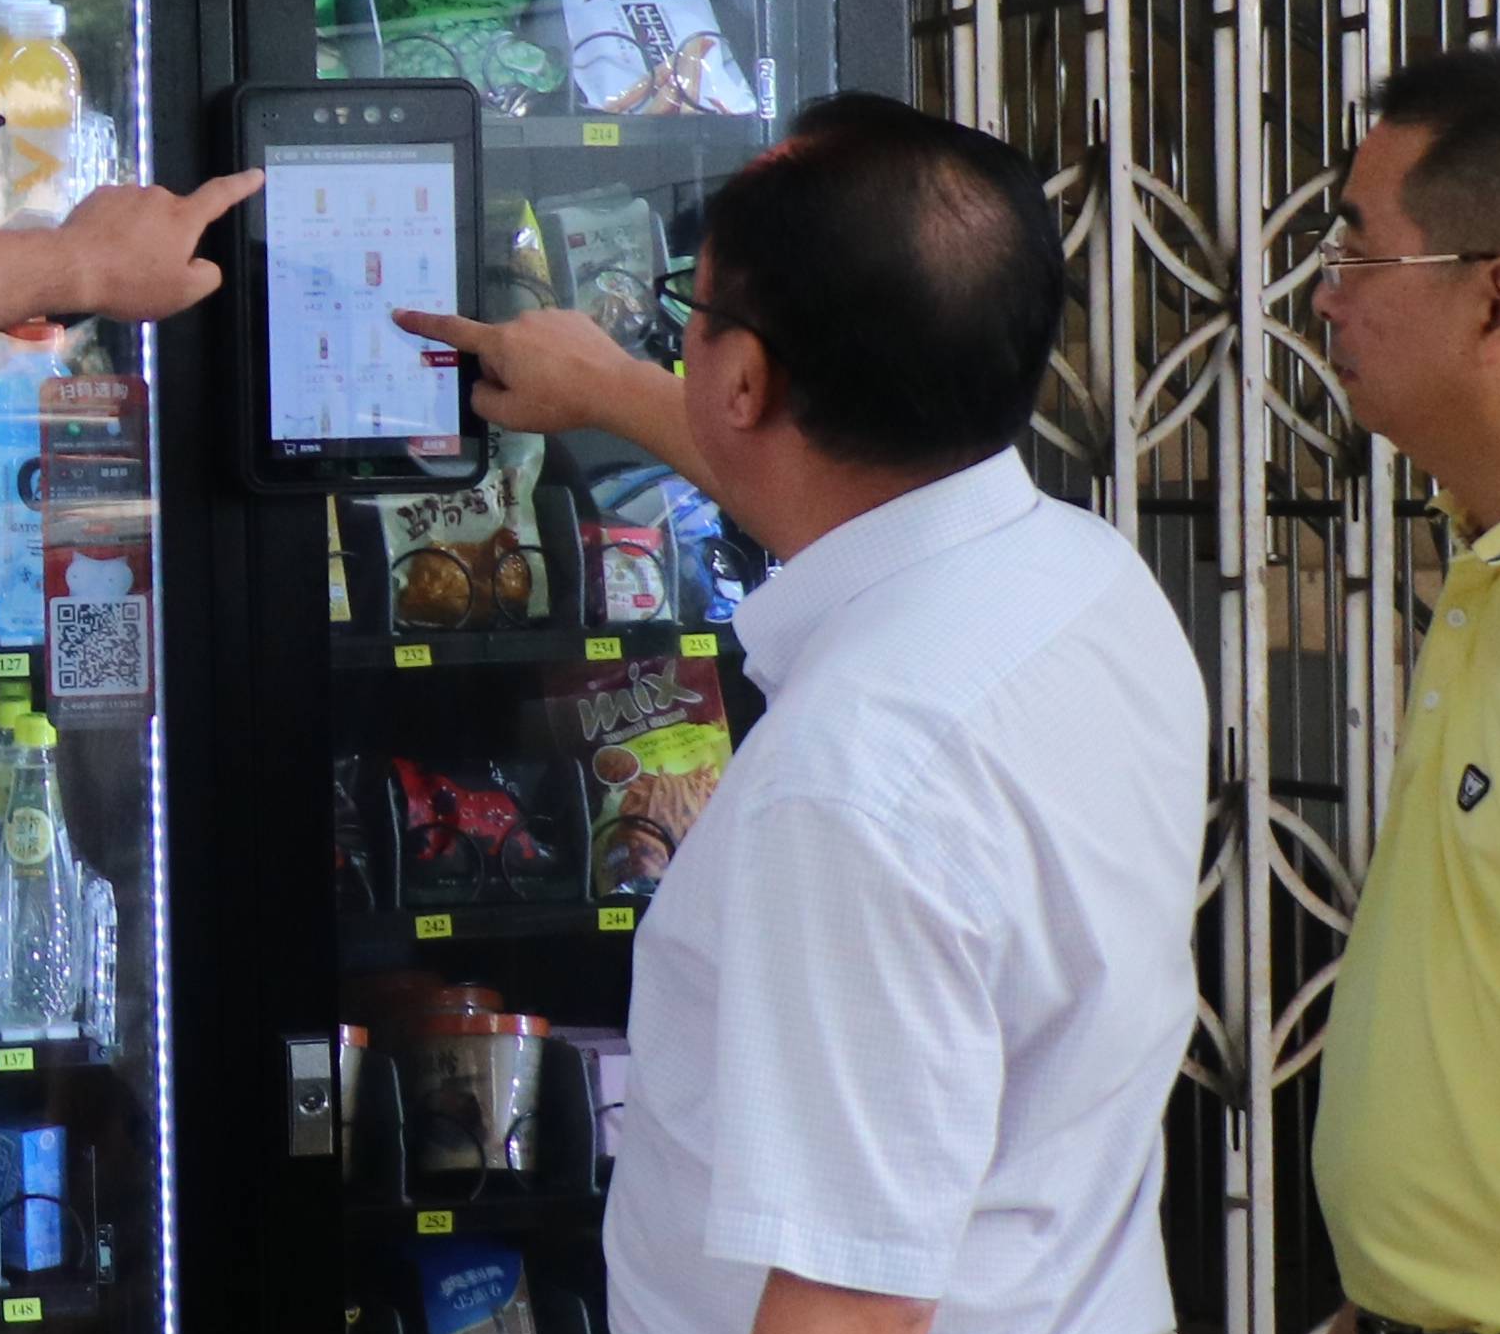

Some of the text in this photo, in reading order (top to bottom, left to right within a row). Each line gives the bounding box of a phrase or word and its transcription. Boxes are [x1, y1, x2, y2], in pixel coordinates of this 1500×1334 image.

[0, 658, 22, 672] 127
[424, 919, 445, 933] 242
[605, 912, 627, 926] 244
[3, 1053, 26, 1067] 137
[424, 1215, 447, 1228] 252
[11, 1302, 34, 1316] 148
